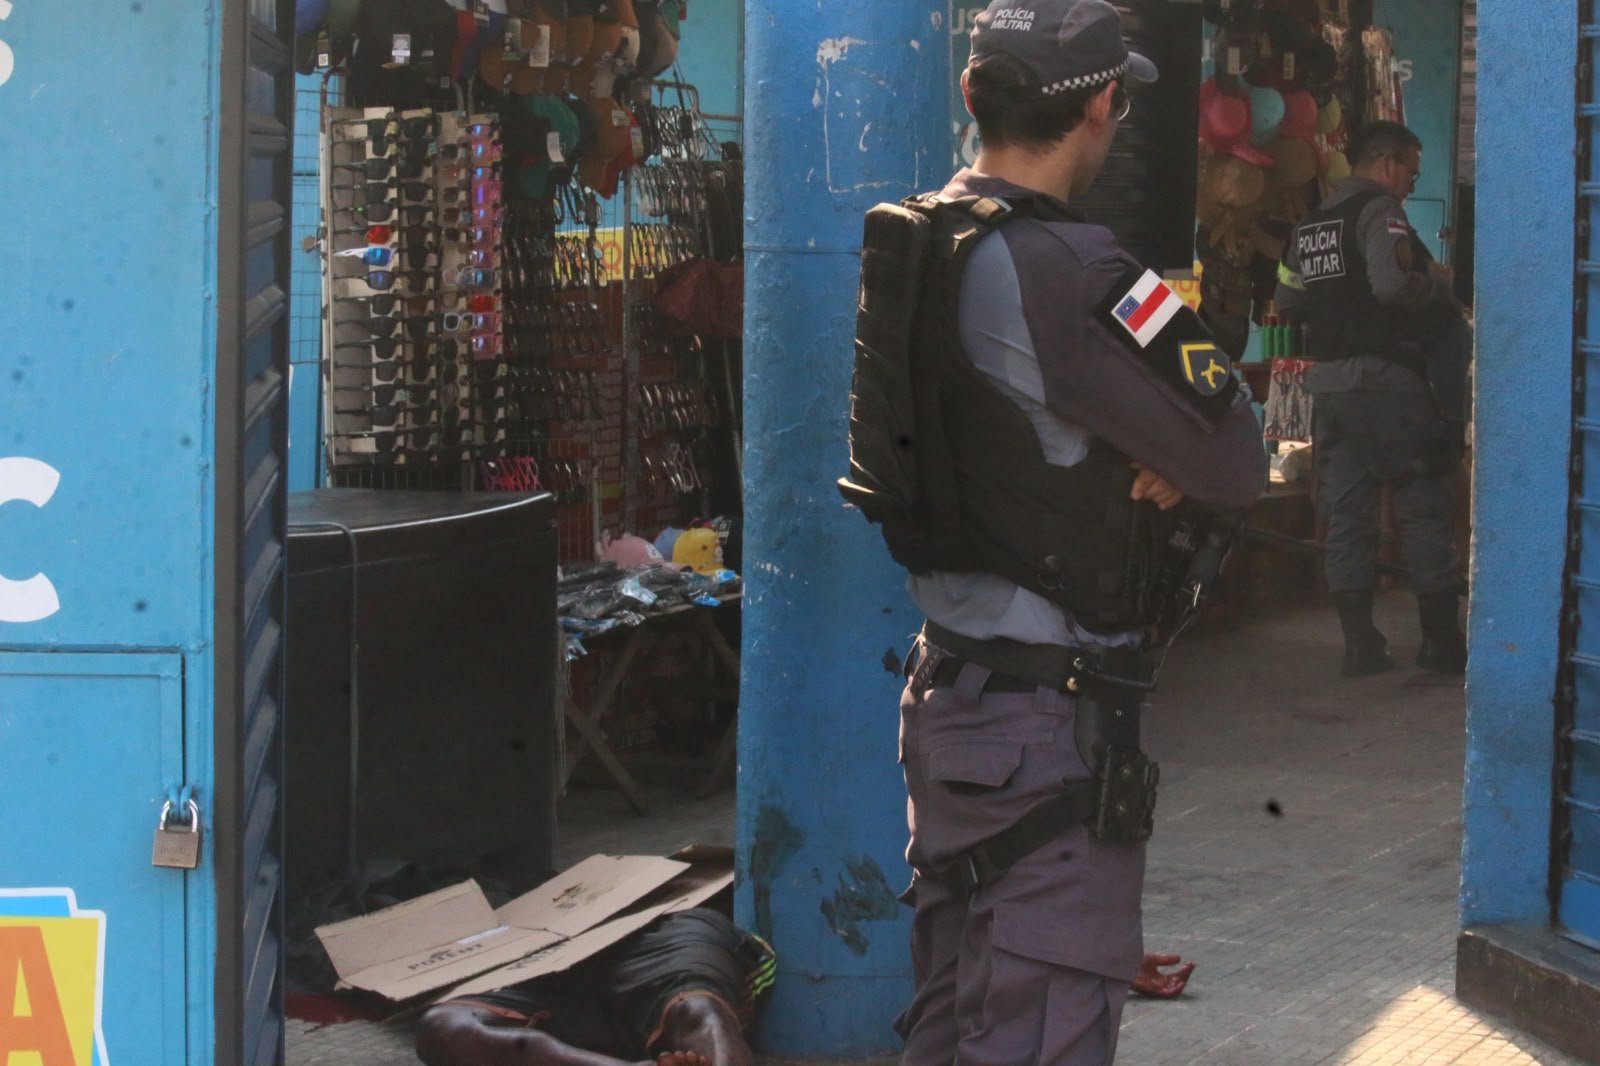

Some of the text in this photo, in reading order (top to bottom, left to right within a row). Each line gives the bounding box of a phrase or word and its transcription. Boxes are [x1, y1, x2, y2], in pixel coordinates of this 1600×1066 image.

[995, 7, 1035, 22] POLÍCIA
[990, 19, 1033, 32] MILITAR
[1299, 226, 1338, 253] POLÍCIA
[1301, 253, 1340, 278] MILITAR
